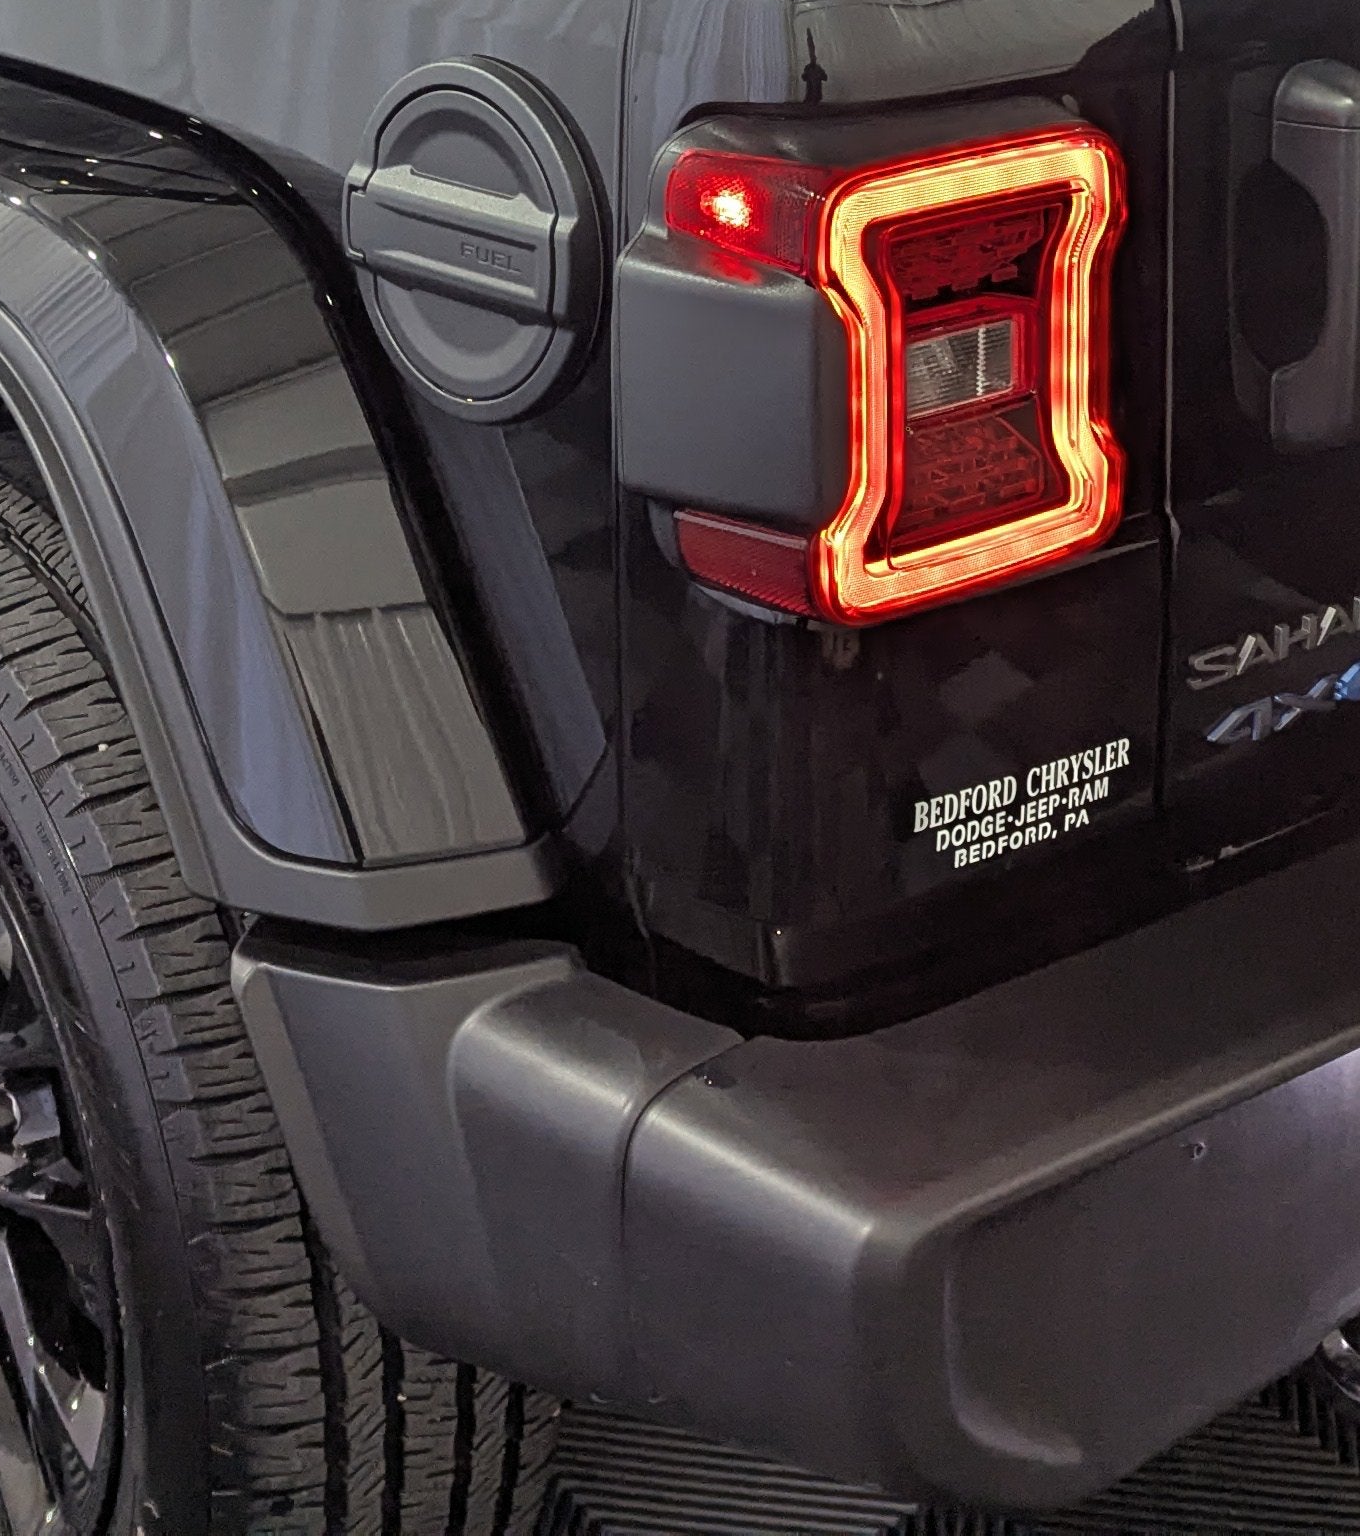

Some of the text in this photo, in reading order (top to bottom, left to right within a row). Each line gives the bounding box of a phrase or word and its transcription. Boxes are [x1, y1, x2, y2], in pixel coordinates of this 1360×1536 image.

[461, 241, 521, 275] FUEL
[912, 737, 1130, 833] BEDFORD CHRYSLER
[953, 808, 1090, 869] BEDFORD, PA
